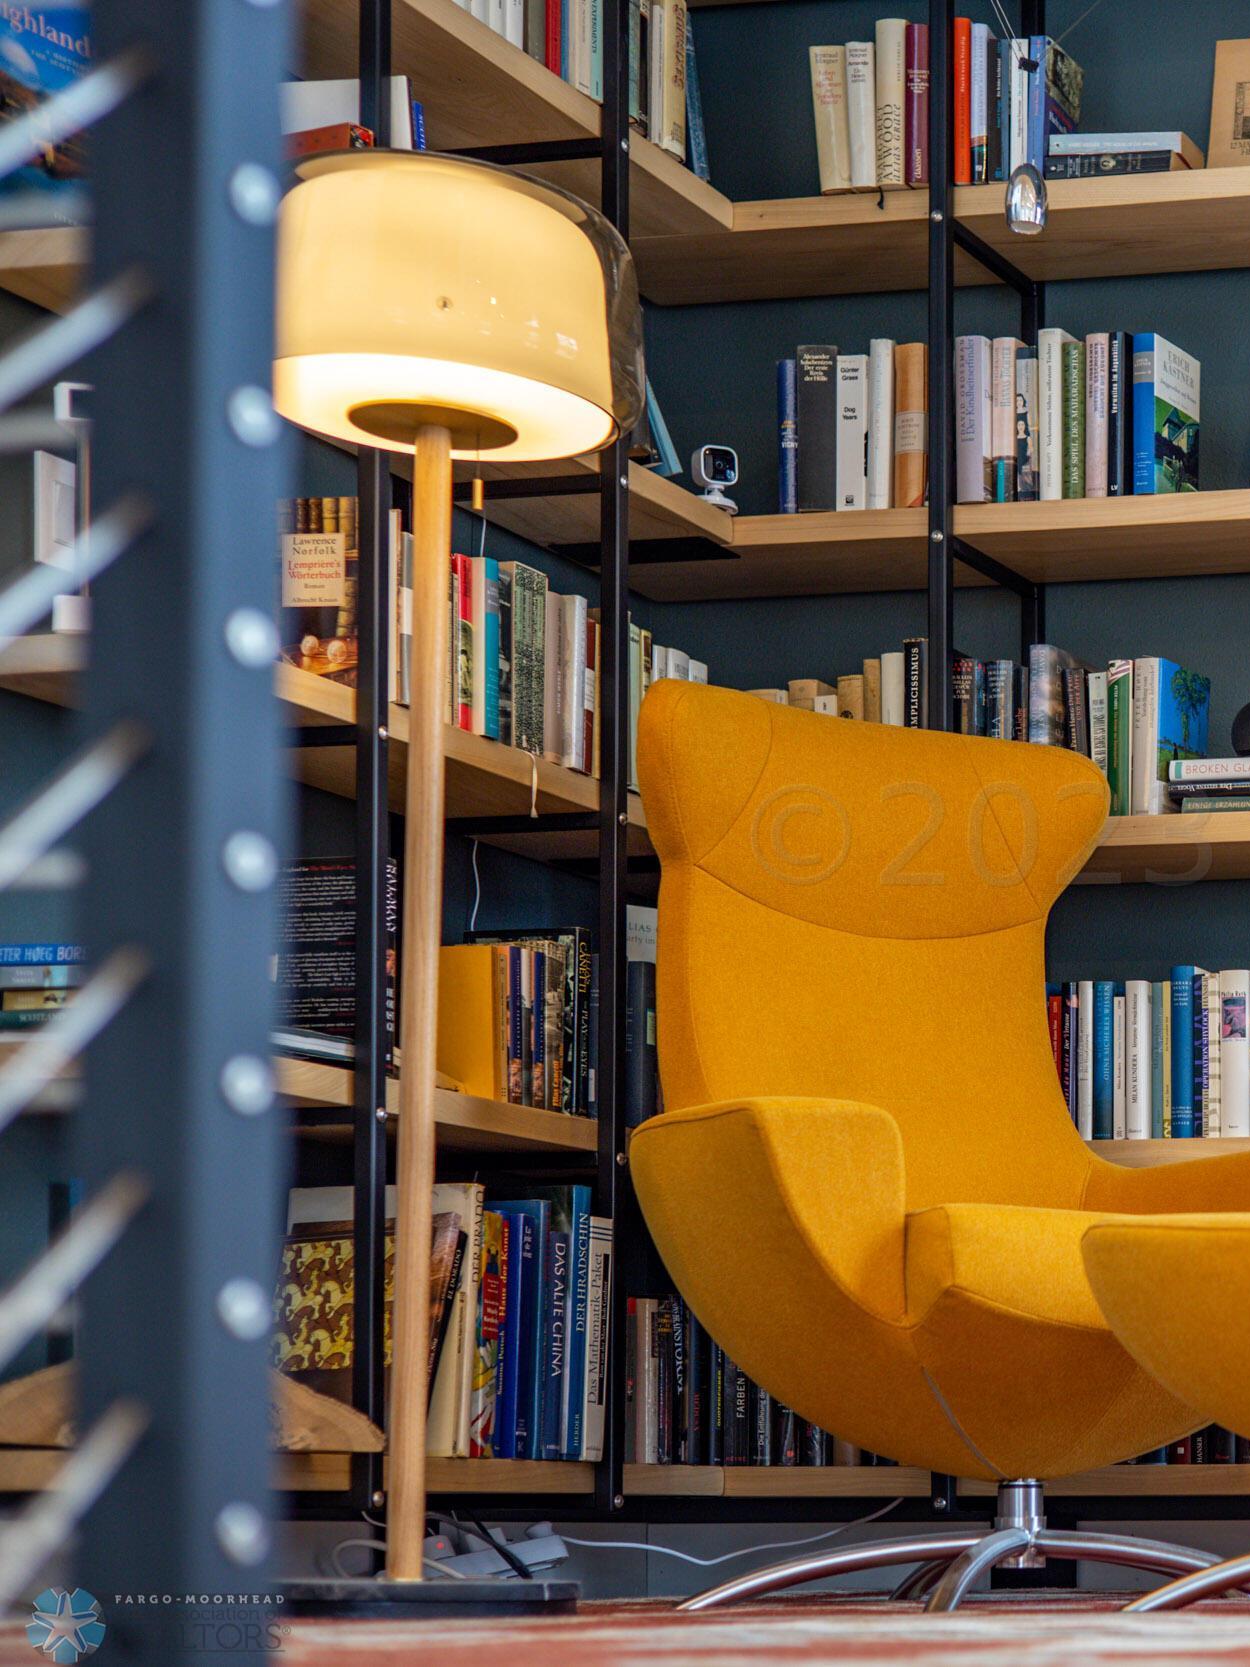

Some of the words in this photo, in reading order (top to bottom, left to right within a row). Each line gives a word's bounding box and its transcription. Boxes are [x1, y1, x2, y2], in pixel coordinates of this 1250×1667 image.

[882, 104, 894, 182] ATWOOD
[1071, 349, 1079, 418] MAHARADSCHAS
[844, 406, 856, 414] Dog
[1071, 419, 1079, 437] DES
[1071, 440, 1079, 464] SPIEL
[1071, 467, 1079, 484] DAS
[292, 536, 337, 546] Lawrence
[292, 546, 337, 556] Norfolk
[1184, 763, 1229, 775] BROKEN
[474, 1190, 485, 1254] PRADO
[501, 1226, 509, 1261] Kunst
[554, 1242, 567, 1277] DAS
[577, 1213, 589, 1303] HRADSCHIN
[449, 1248, 462, 1288] DORADO
[472, 1264, 480, 1286] DER
[591, 1254, 604, 1296] Paket
[447, 1290, 453, 1300] EL
[499, 1287, 507, 1317] Haus
[552, 1280, 564, 1318] ALTE
[575, 1305, 586, 1333] DER
[550, 1322, 563, 1378] CHINA
[589, 1299, 601, 1382] Mathematik
[588, 1383, 597, 1405] Das
[736, 1377, 745, 1420] FARBEN
[573, 1413, 581, 1447] HERDER
